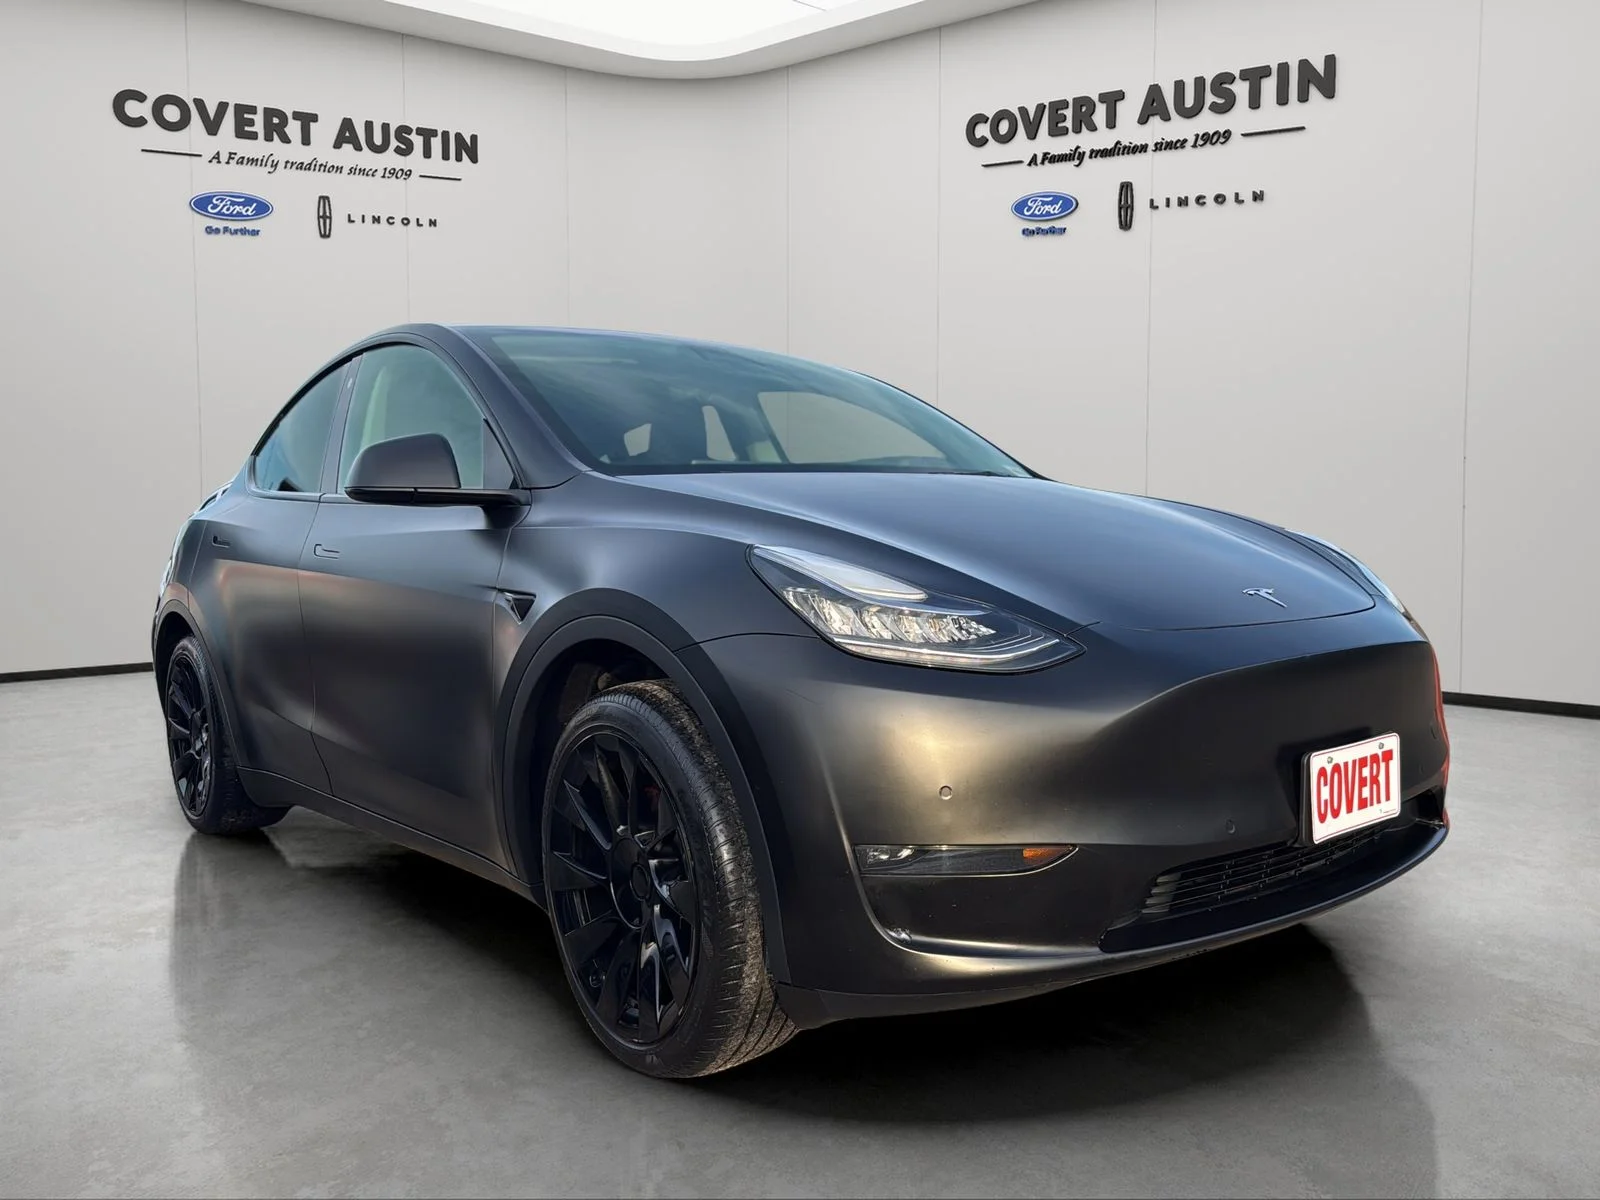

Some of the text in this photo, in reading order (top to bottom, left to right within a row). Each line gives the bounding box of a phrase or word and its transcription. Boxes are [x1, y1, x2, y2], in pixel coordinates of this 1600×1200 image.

[965, 53, 1337, 148] COVERT AUSTIN
[112, 88, 479, 164] COVERT AUSTIN
[1026, 128, 1232, 168] A Family tradition since 1909
[208, 151, 413, 181] A Family tradition since 1909
[207, 195, 257, 216] Ford
[1023, 196, 1063, 216] Ford
[1149, 189, 1266, 210] LINCOLN
[347, 213, 438, 228] LINCOLN
[1316, 748, 1394, 824] COVERT
